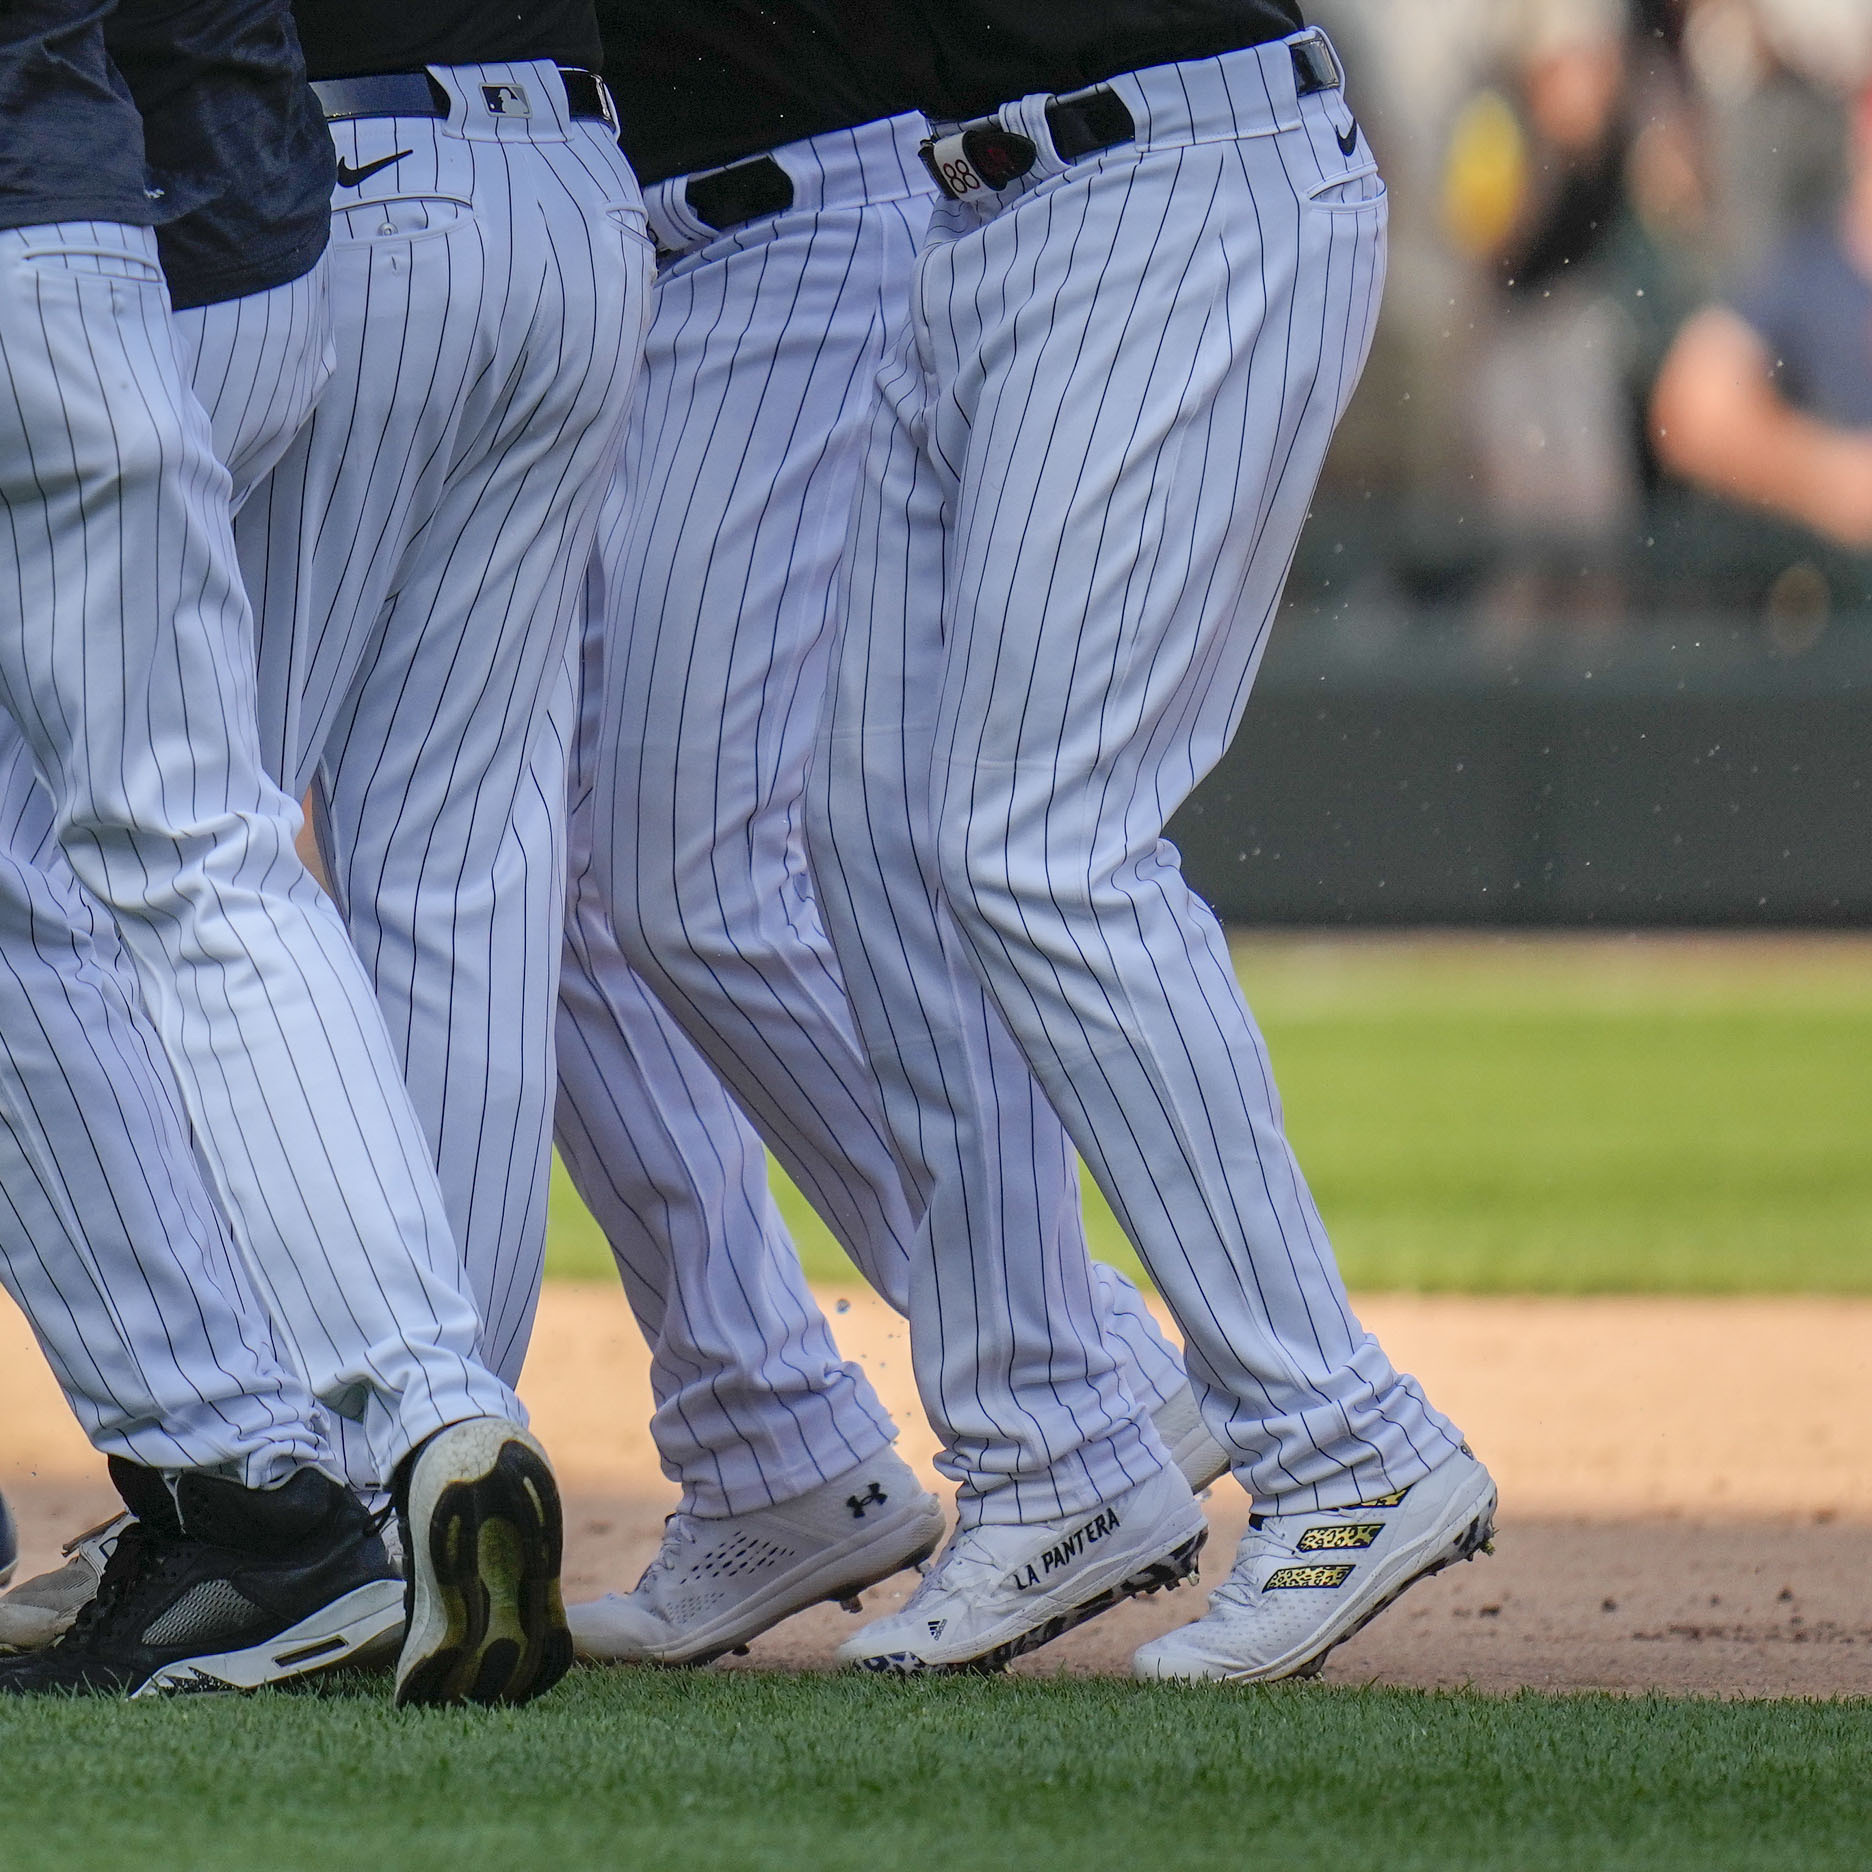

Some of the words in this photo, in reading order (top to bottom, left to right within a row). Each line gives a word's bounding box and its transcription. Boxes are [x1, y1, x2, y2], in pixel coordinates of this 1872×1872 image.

[943, 159, 981, 194] 88
[1013, 1564, 1040, 1590] LA
[1041, 1507, 1120, 1574] PANTERA
